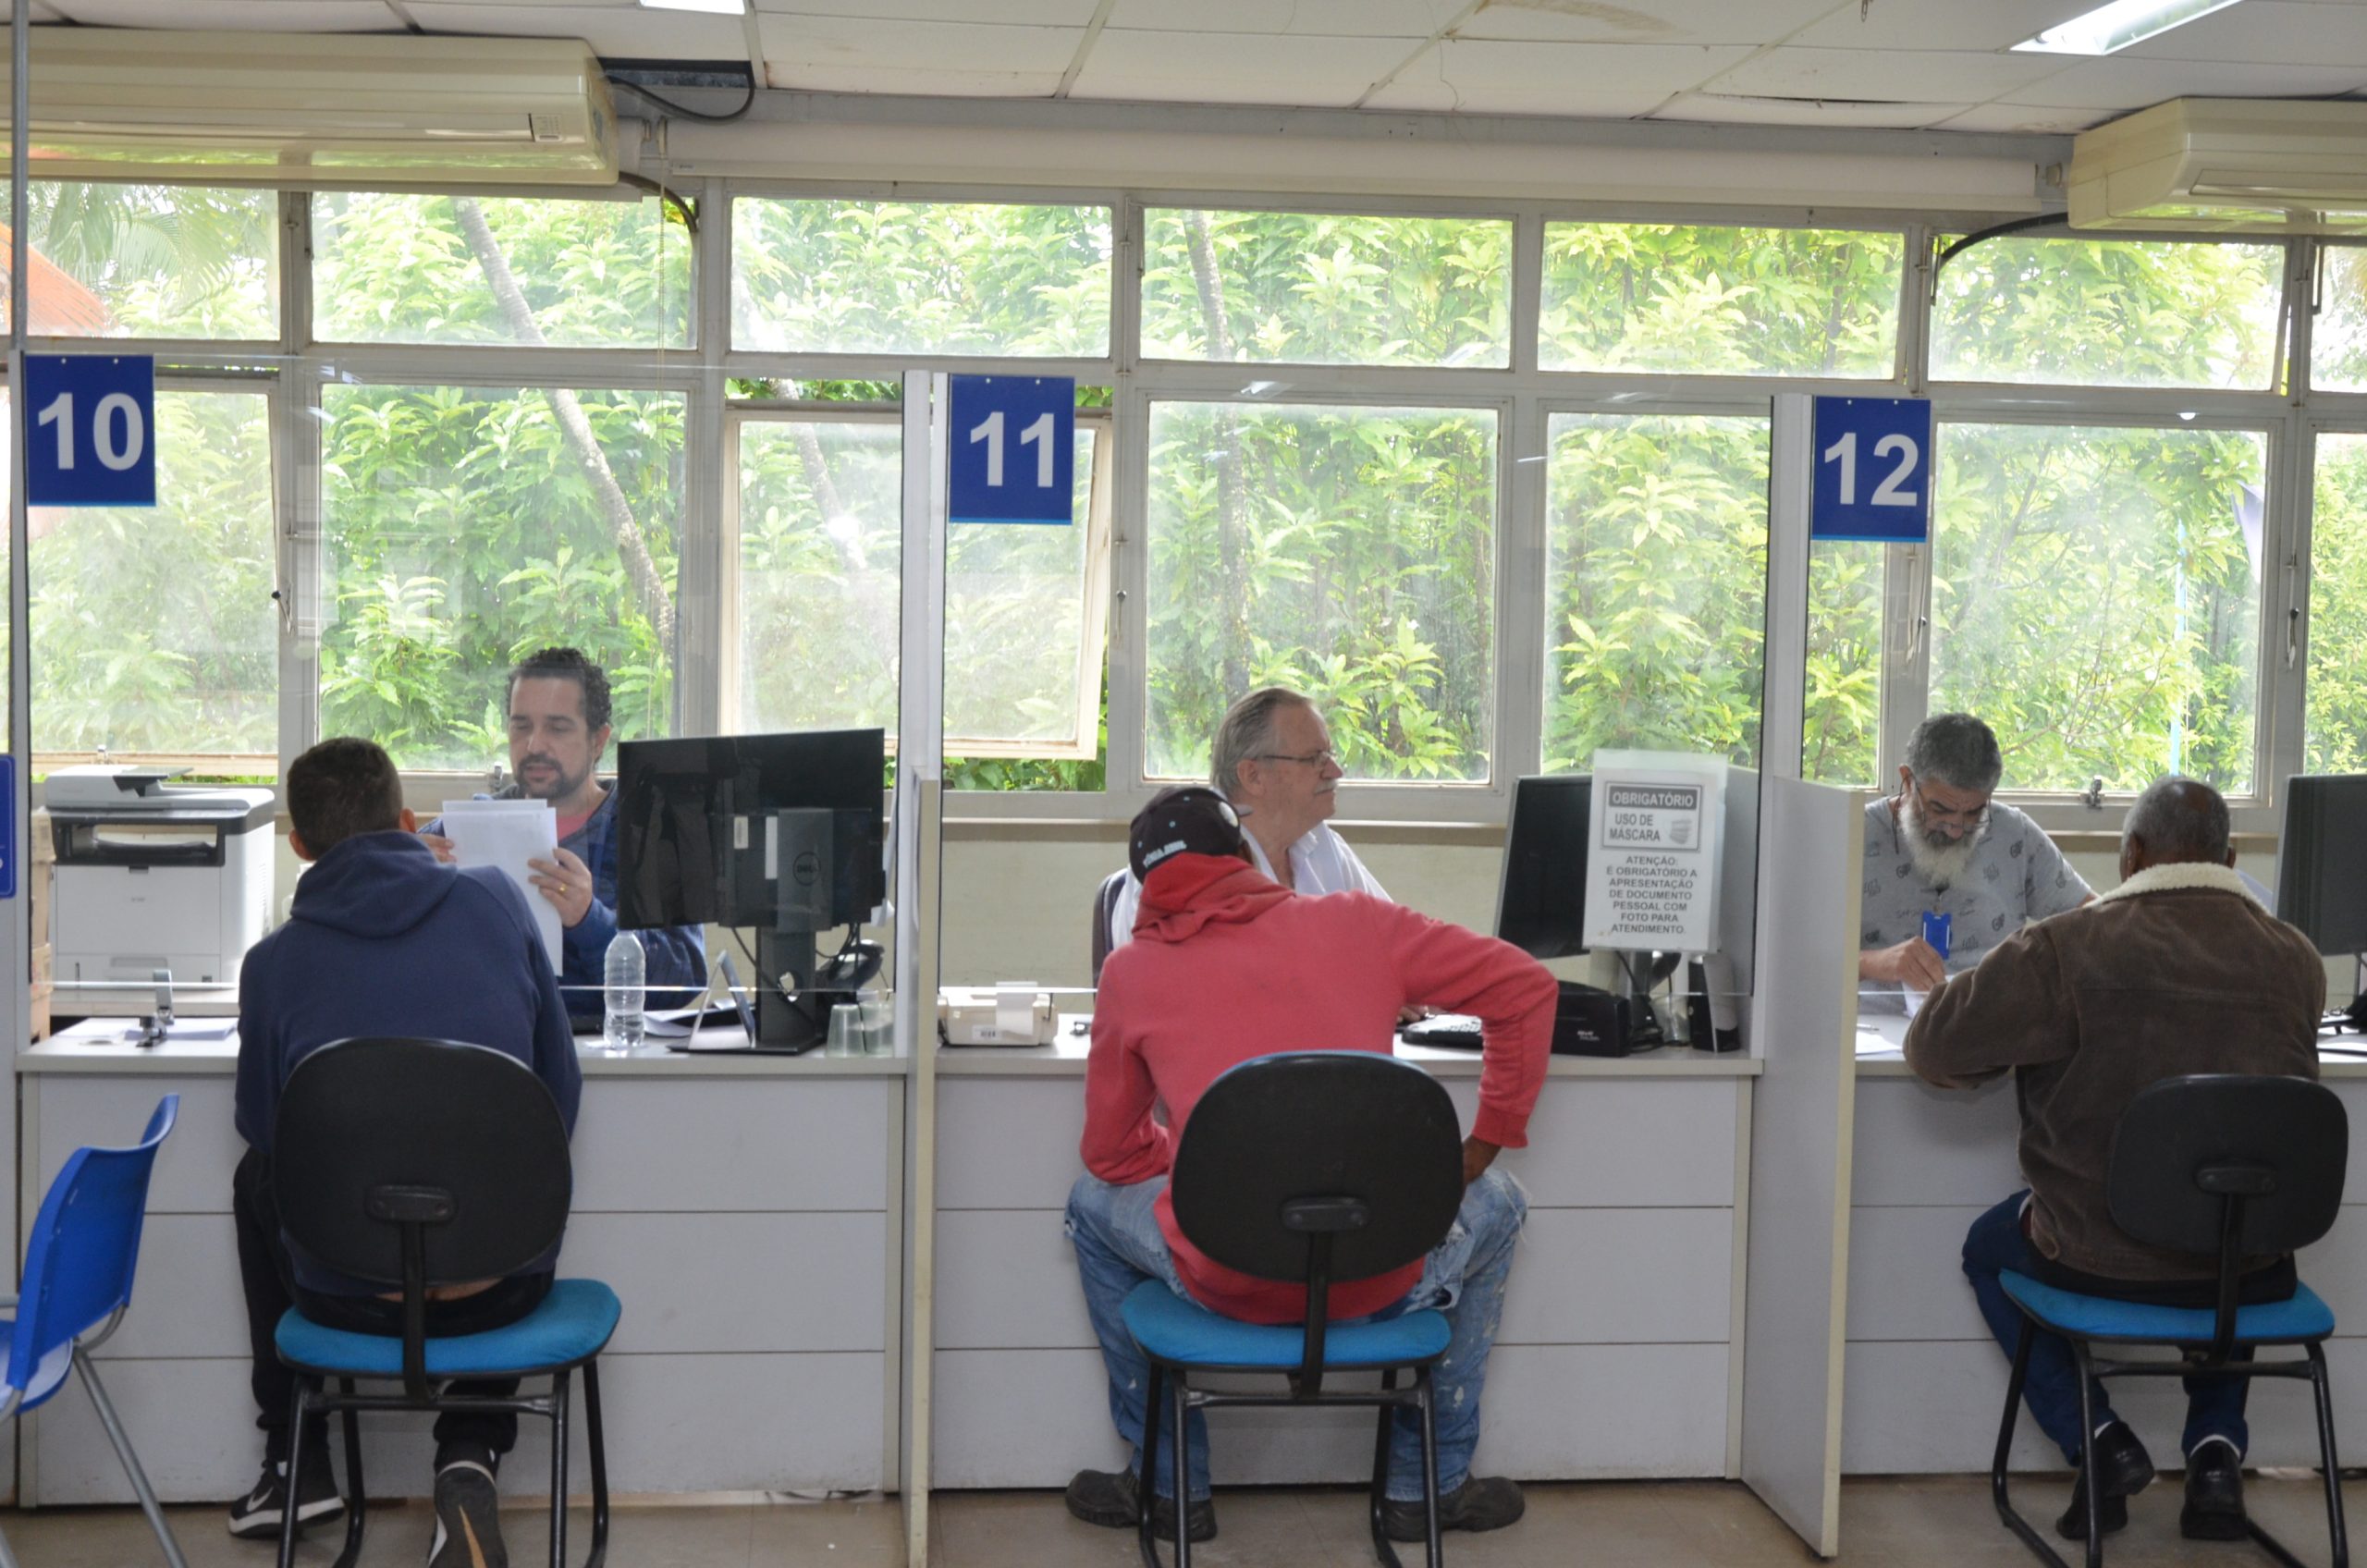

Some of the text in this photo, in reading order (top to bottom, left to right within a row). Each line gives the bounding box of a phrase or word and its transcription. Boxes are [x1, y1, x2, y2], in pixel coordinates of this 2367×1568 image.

[37, 392, 144, 470] 10
[970, 410, 1054, 488] 11
[1823, 432, 1919, 507] 12
[1612, 790, 1694, 807] OBRIGATÓRIO
[1614, 813, 1654, 827] USO DE
[1609, 826, 1661, 842] MÁSCARA
[1606, 864, 1699, 878] É OBRIGATÓRIO A
[1609, 877, 1694, 889] APRESENTAÇÃO
[1609, 888, 1693, 900] DE DOCUMENTO
[1613, 900, 1687, 912] PESSOAL COM
[1620, 912, 1679, 923] FOTO PARA
[1612, 924, 1686, 935] ATENDIMENTO.
